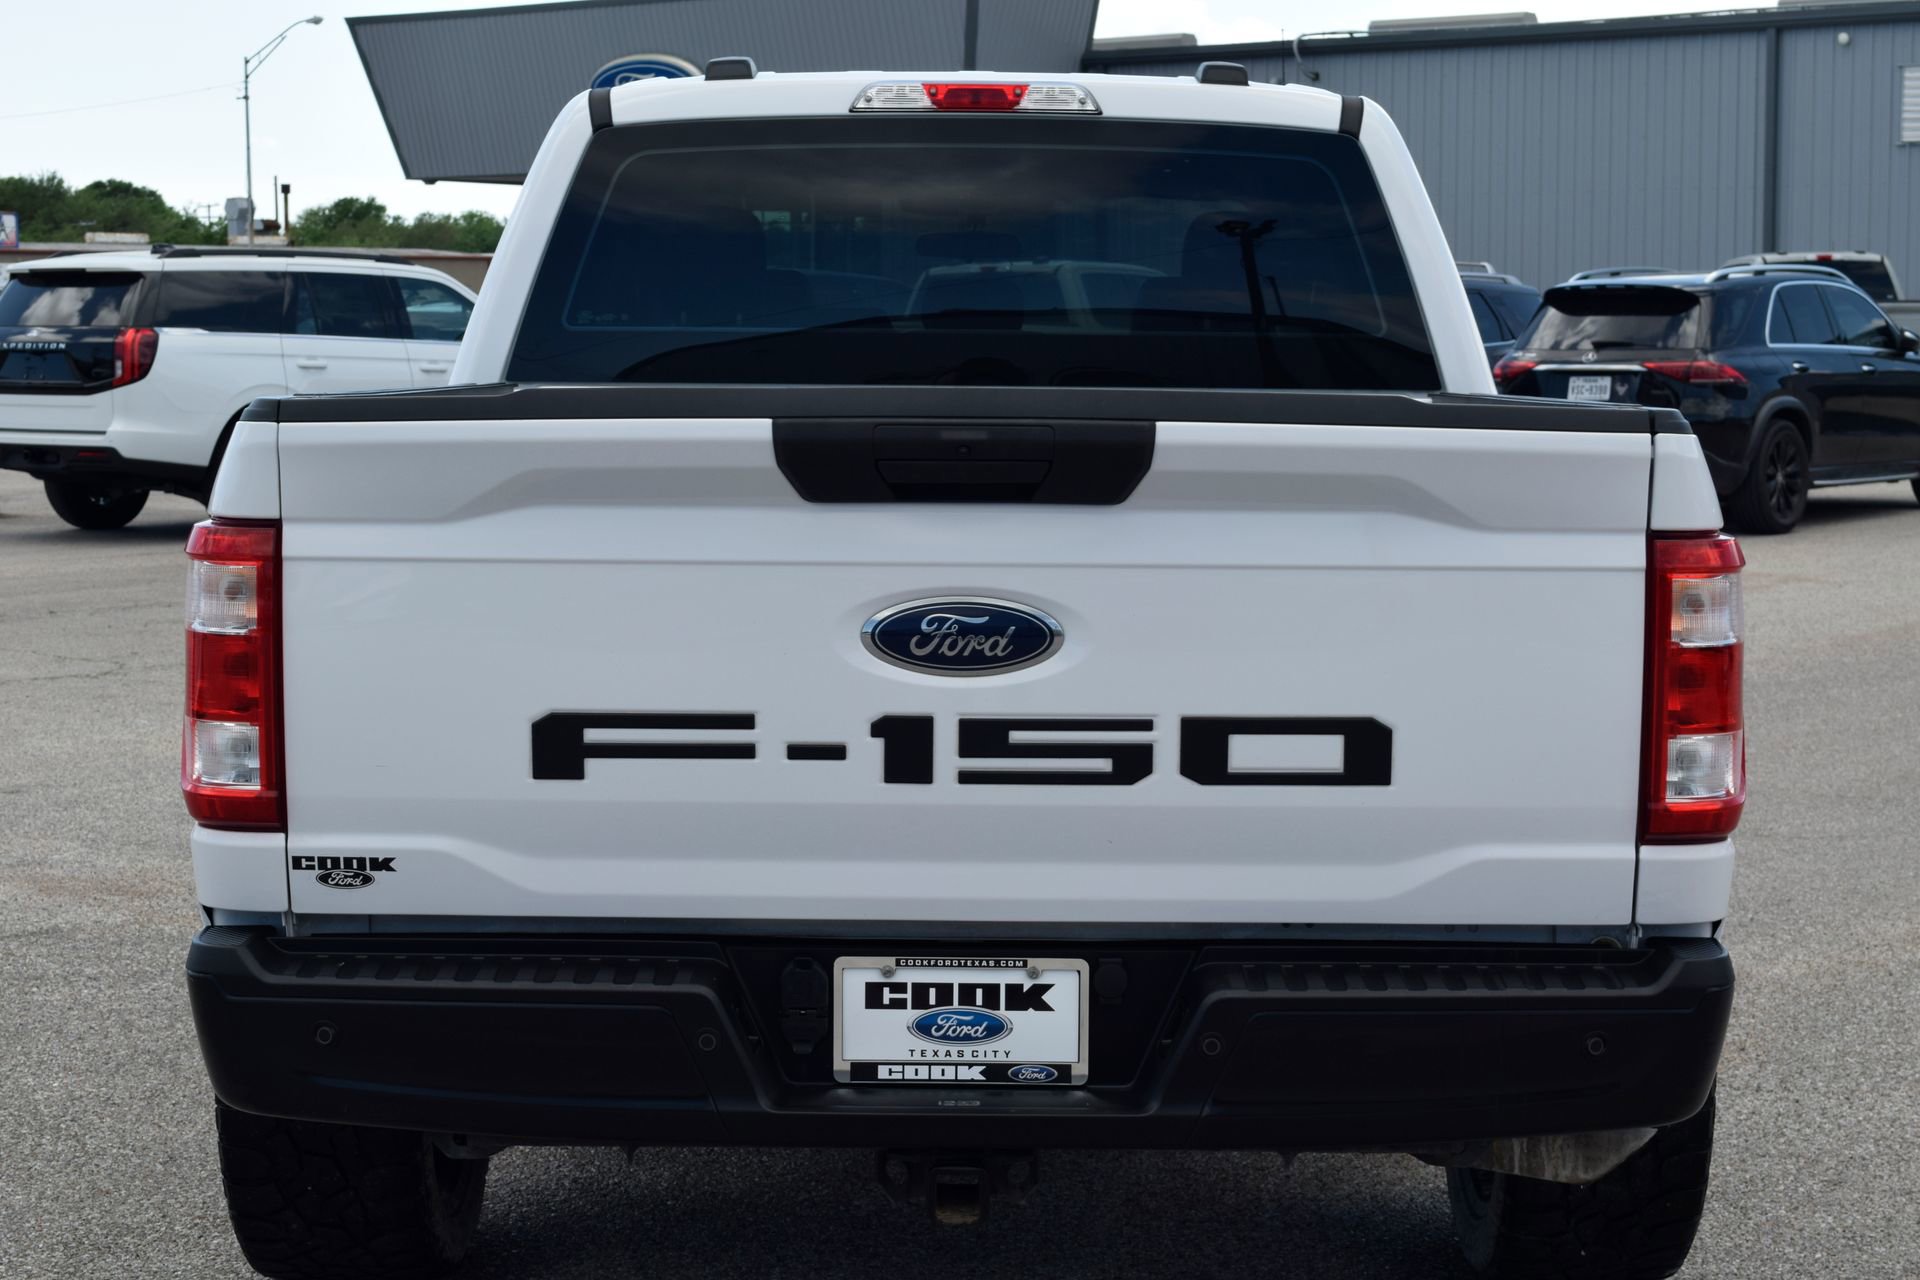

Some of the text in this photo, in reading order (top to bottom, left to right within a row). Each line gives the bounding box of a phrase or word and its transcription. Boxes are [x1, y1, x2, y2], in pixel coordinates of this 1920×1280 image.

[909, 613, 1016, 656] Ford
[532, 711, 1394, 786] F-150
[291, 855, 398, 872] COOK
[328, 871, 364, 886] Ford
[865, 981, 1056, 1012] COOK
[931, 1013, 988, 1039] Ford
[908, 1049, 1012, 1059] TEXAS CITY
[877, 1064, 1046, 1081] COOK Ford
